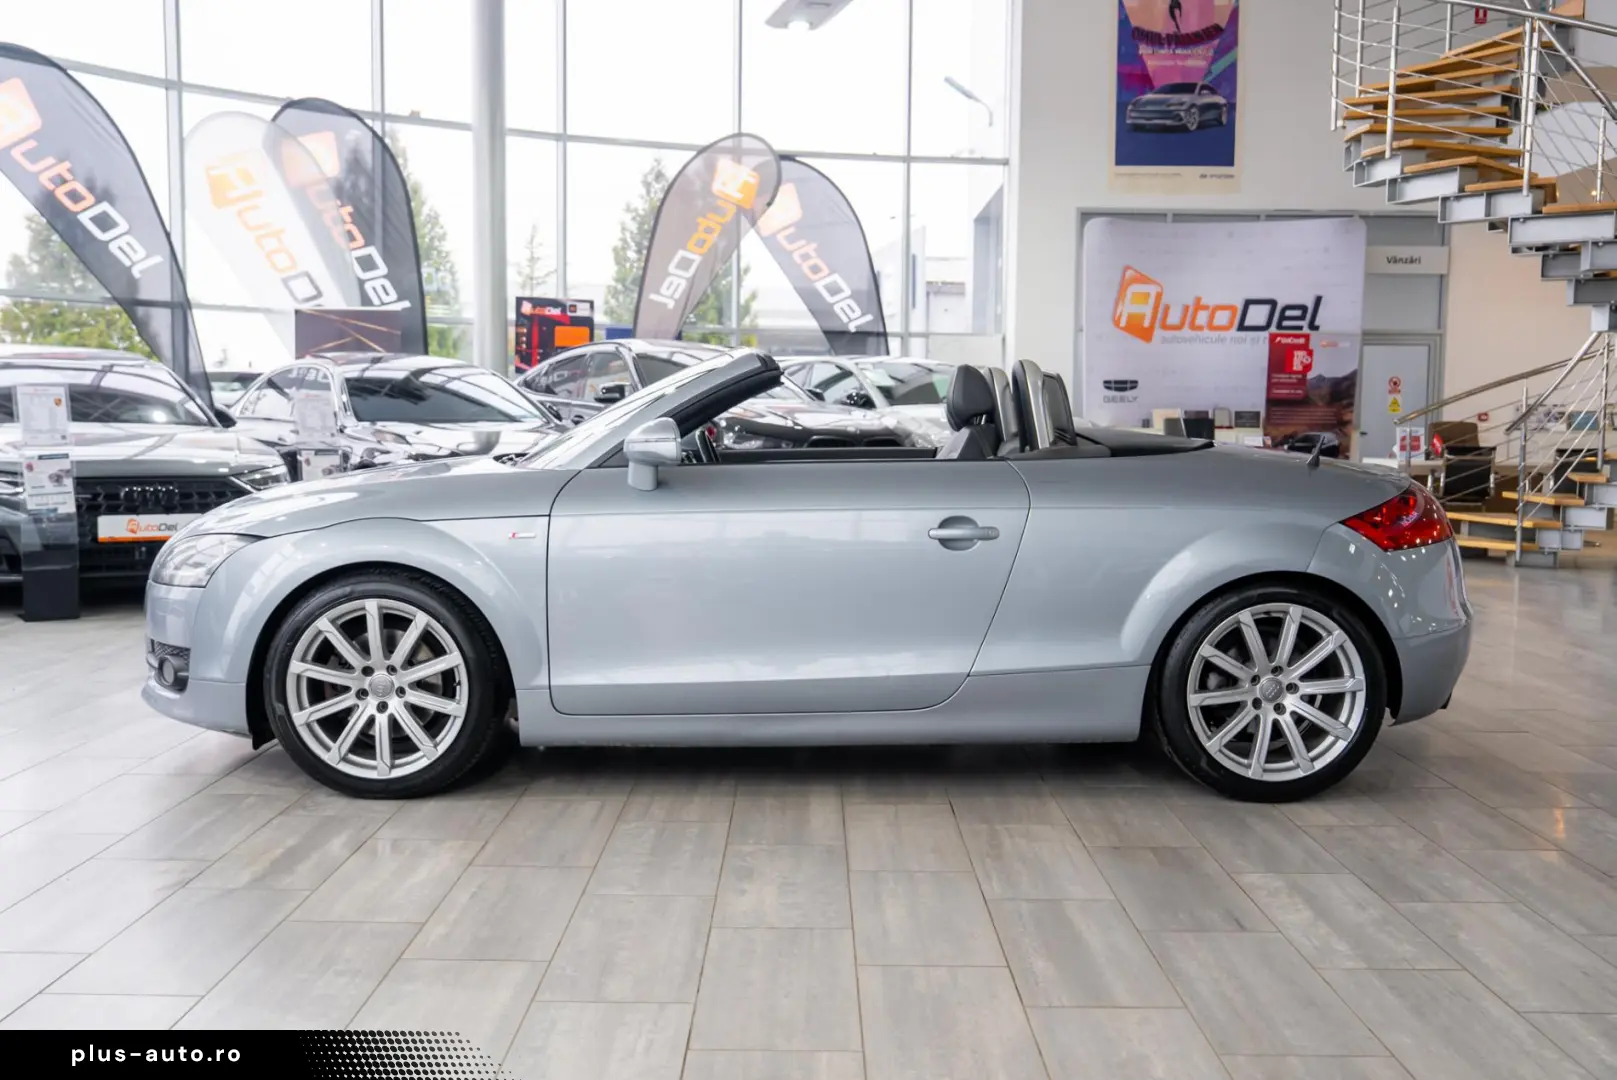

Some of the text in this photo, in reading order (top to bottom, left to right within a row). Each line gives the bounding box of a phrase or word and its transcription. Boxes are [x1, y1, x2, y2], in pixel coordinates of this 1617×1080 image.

[1386, 255, 1422, 264] Vânzări
[1112, 264, 1323, 344] AutoDel
[1160, 334, 1227, 345] autovehicule
